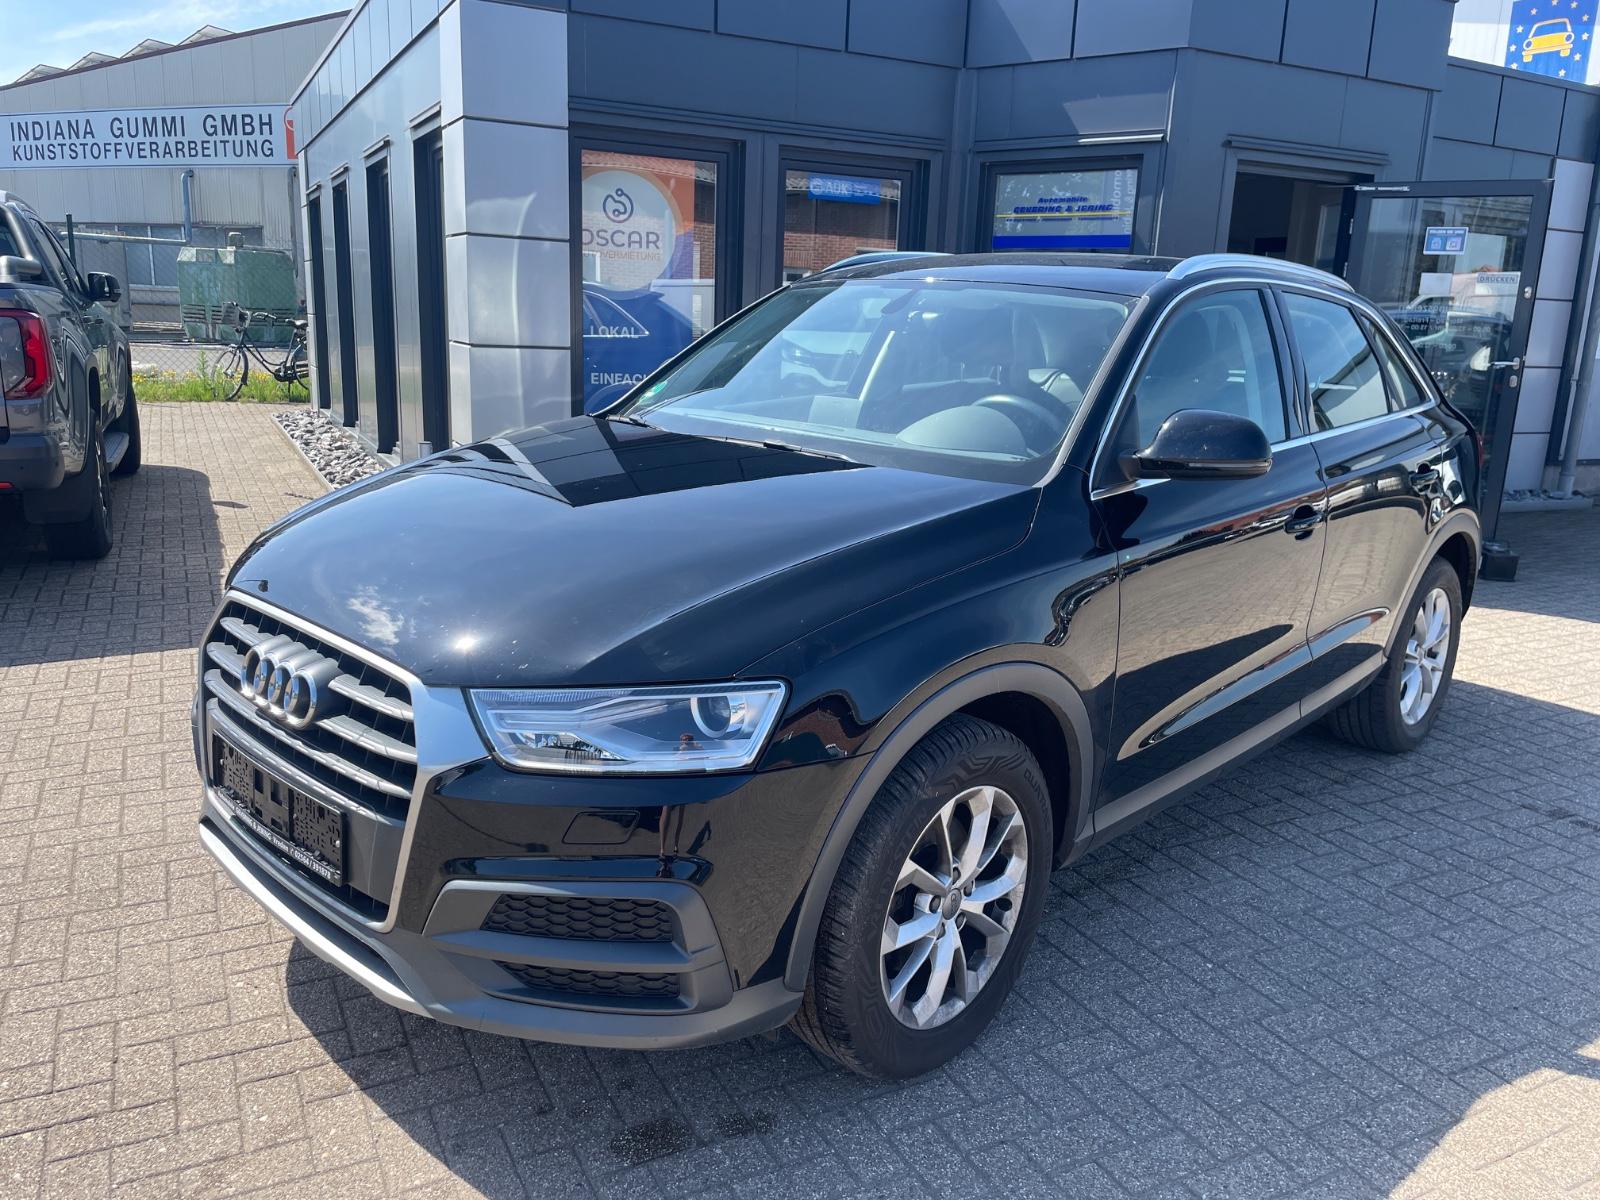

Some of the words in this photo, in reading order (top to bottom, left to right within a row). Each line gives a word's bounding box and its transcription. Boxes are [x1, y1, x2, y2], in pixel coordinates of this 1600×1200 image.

[10, 118, 96, 142] INDIANA
[109, 115, 187, 139] GUMMI
[203, 113, 274, 137] GMBH
[12, 139, 275, 162] KUNSTSTOFFVERARBEITUNG
[582, 228, 661, 250] OSCAR
[590, 325, 639, 339] LOKAL
